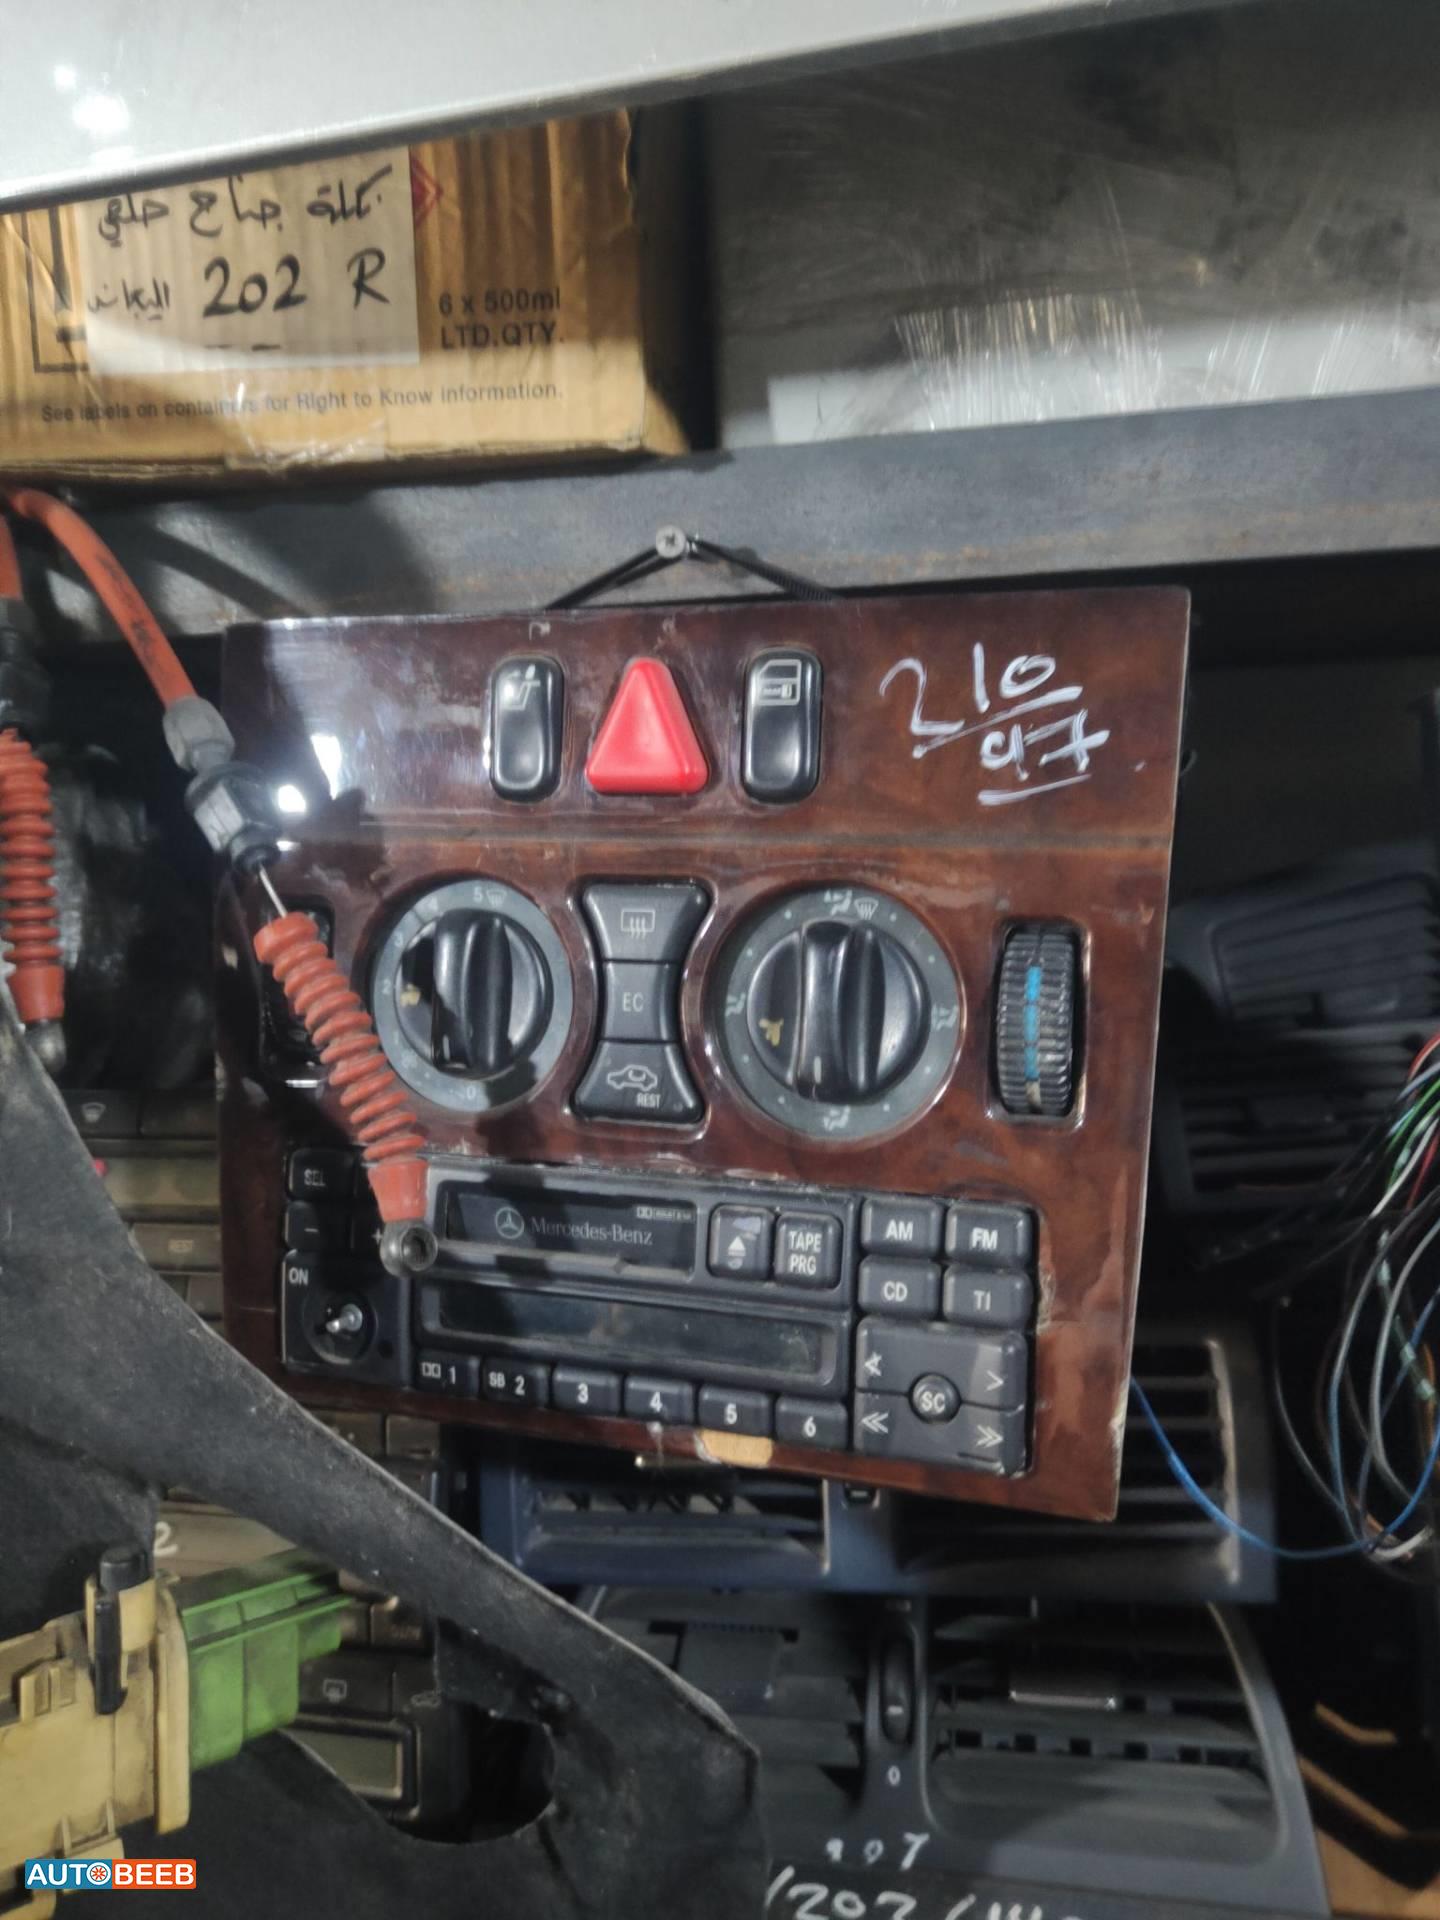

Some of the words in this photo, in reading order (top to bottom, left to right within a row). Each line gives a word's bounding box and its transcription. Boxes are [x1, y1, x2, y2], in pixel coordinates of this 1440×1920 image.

[203, 254, 307, 318] 202
[346, 247, 390, 310] R
[438, 292, 453, 316] 6
[484, 286, 561, 314] 500ml
[41, 404, 74, 423] See
[136, 403, 158, 418] on
[265, 393, 289, 412] for
[296, 390, 347, 414] Right
[353, 390, 372, 408] to
[379, 387, 433, 407] Know
[440, 382, 563, 402] information.
[382, 979, 392, 995] 2
[623, 991, 644, 1013] EC
[636, 1092, 660, 1109] REST
[303, 1168, 326, 1187] SEL
[530, 1216, 653, 1246] Mercedes-Benz
[788, 1229, 822, 1253] TAPE
[885, 1218, 914, 1242] AM
[971, 1226, 998, 1250] FM
[288, 1266, 309, 1286] ON
[789, 1254, 817, 1277] PRG
[883, 1279, 909, 1301] CD
[449, 1366, 457, 1385] 1
[514, 1375, 526, 1396] 2
[577, 1382, 589, 1404] 3
[650, 1391, 663, 1413] 4
[920, 1390, 946, 1415] SC
[724, 1402, 738, 1425] 5
[803, 1415, 817, 1438] 6
